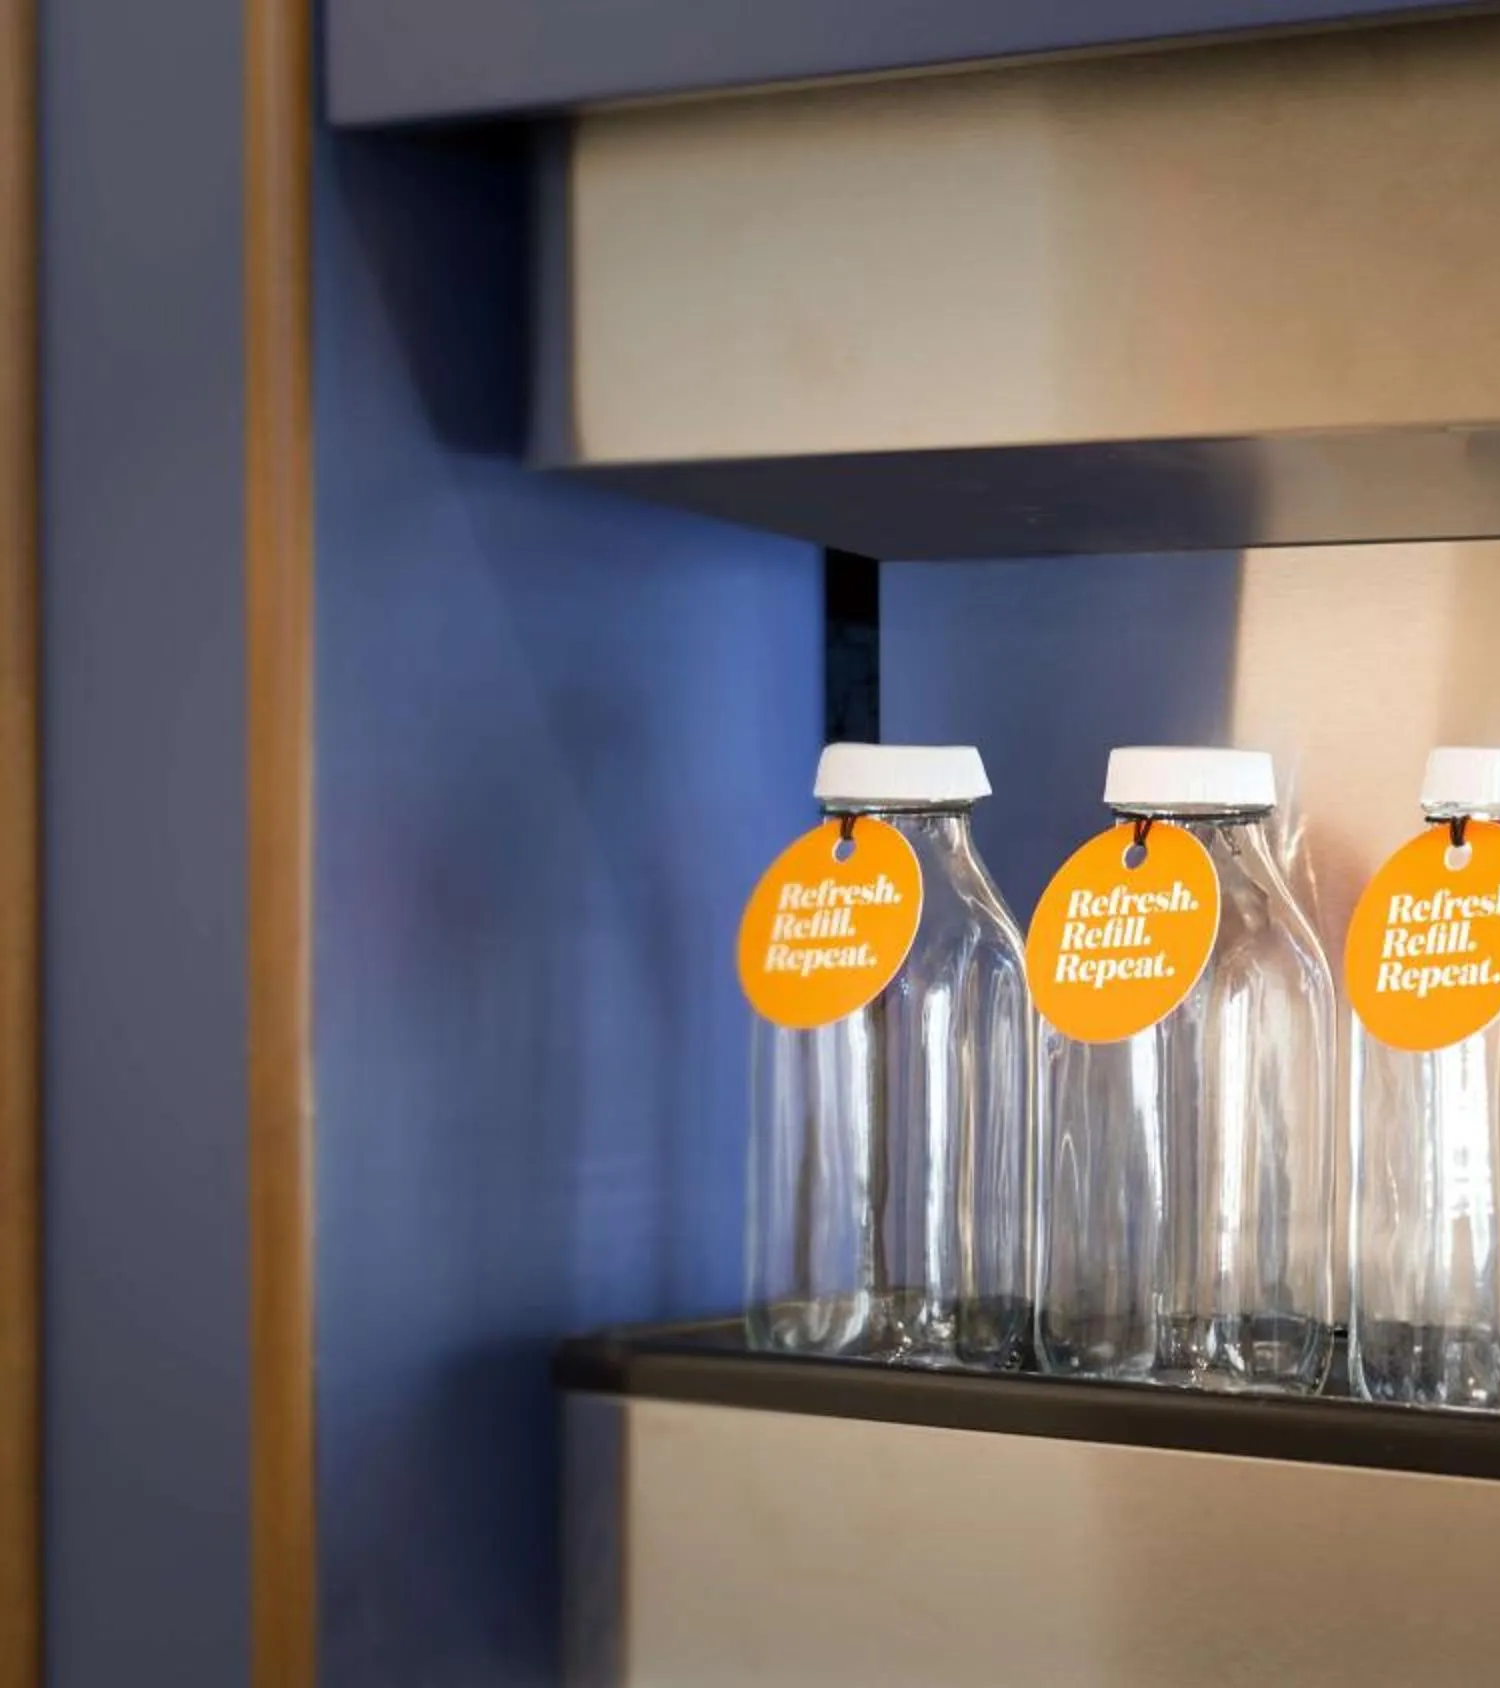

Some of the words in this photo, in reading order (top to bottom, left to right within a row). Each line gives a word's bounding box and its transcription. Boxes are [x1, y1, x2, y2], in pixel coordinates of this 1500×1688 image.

[779, 874, 901, 909] Refresh.
[1067, 880, 1199, 919] Refresh.
[772, 906, 856, 941] Refill.
[1060, 914, 1152, 950] Refill.
[1381, 918, 1478, 957] Refill.
[764, 943, 876, 974] Repeat.
[1055, 953, 1175, 989] Repeat.
